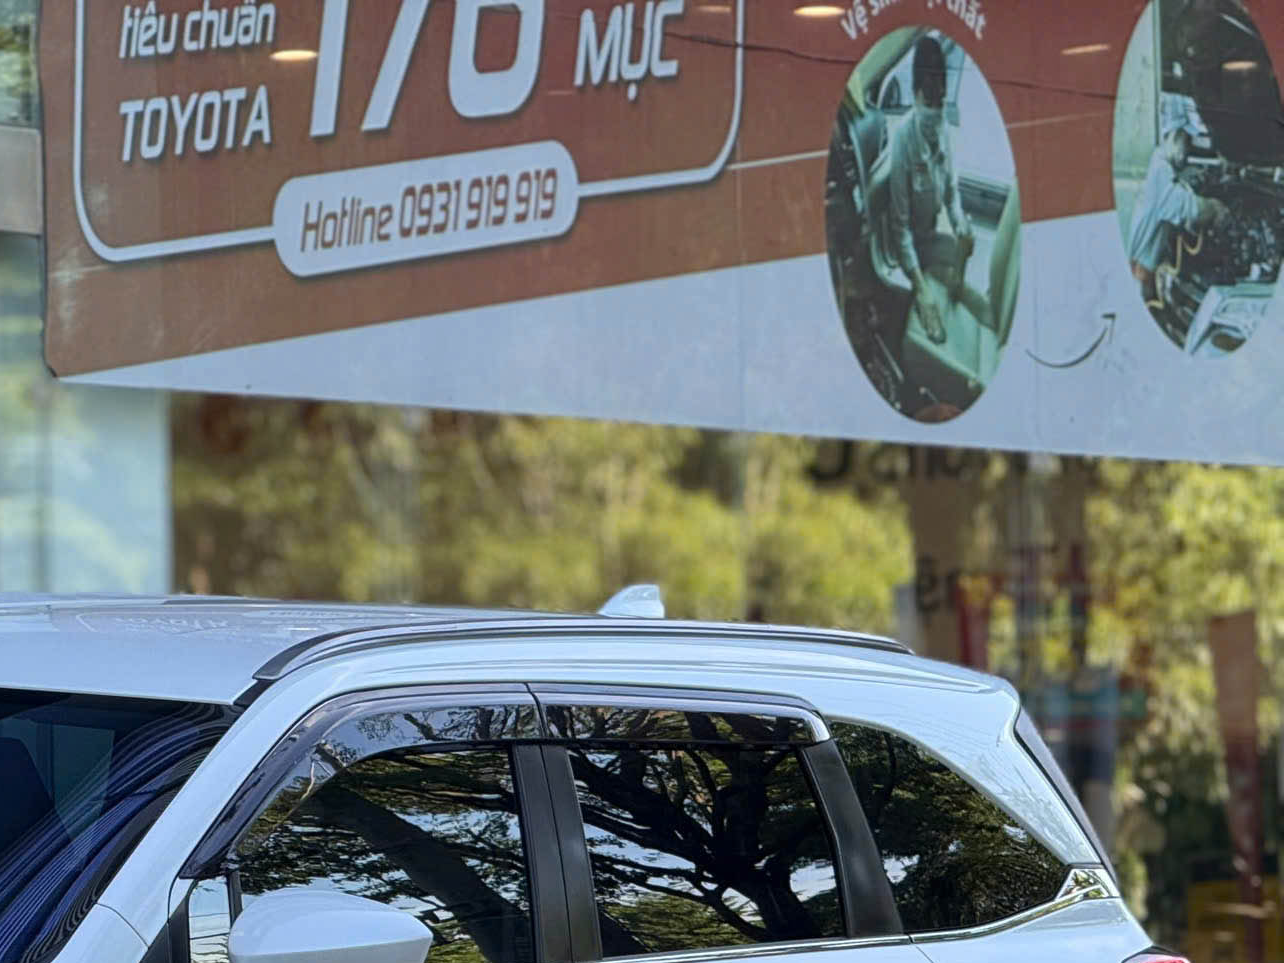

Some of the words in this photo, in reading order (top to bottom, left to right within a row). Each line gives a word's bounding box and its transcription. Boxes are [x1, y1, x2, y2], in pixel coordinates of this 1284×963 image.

[118, 0, 178, 59] tiêu
[574, 0, 685, 101] MỤC
[119, 84, 272, 162] TOYOTA
[300, 196, 393, 253] Hotline
[399, 179, 462, 239] 0931
[466, 174, 510, 230] 919
[514, 167, 558, 224] 919
